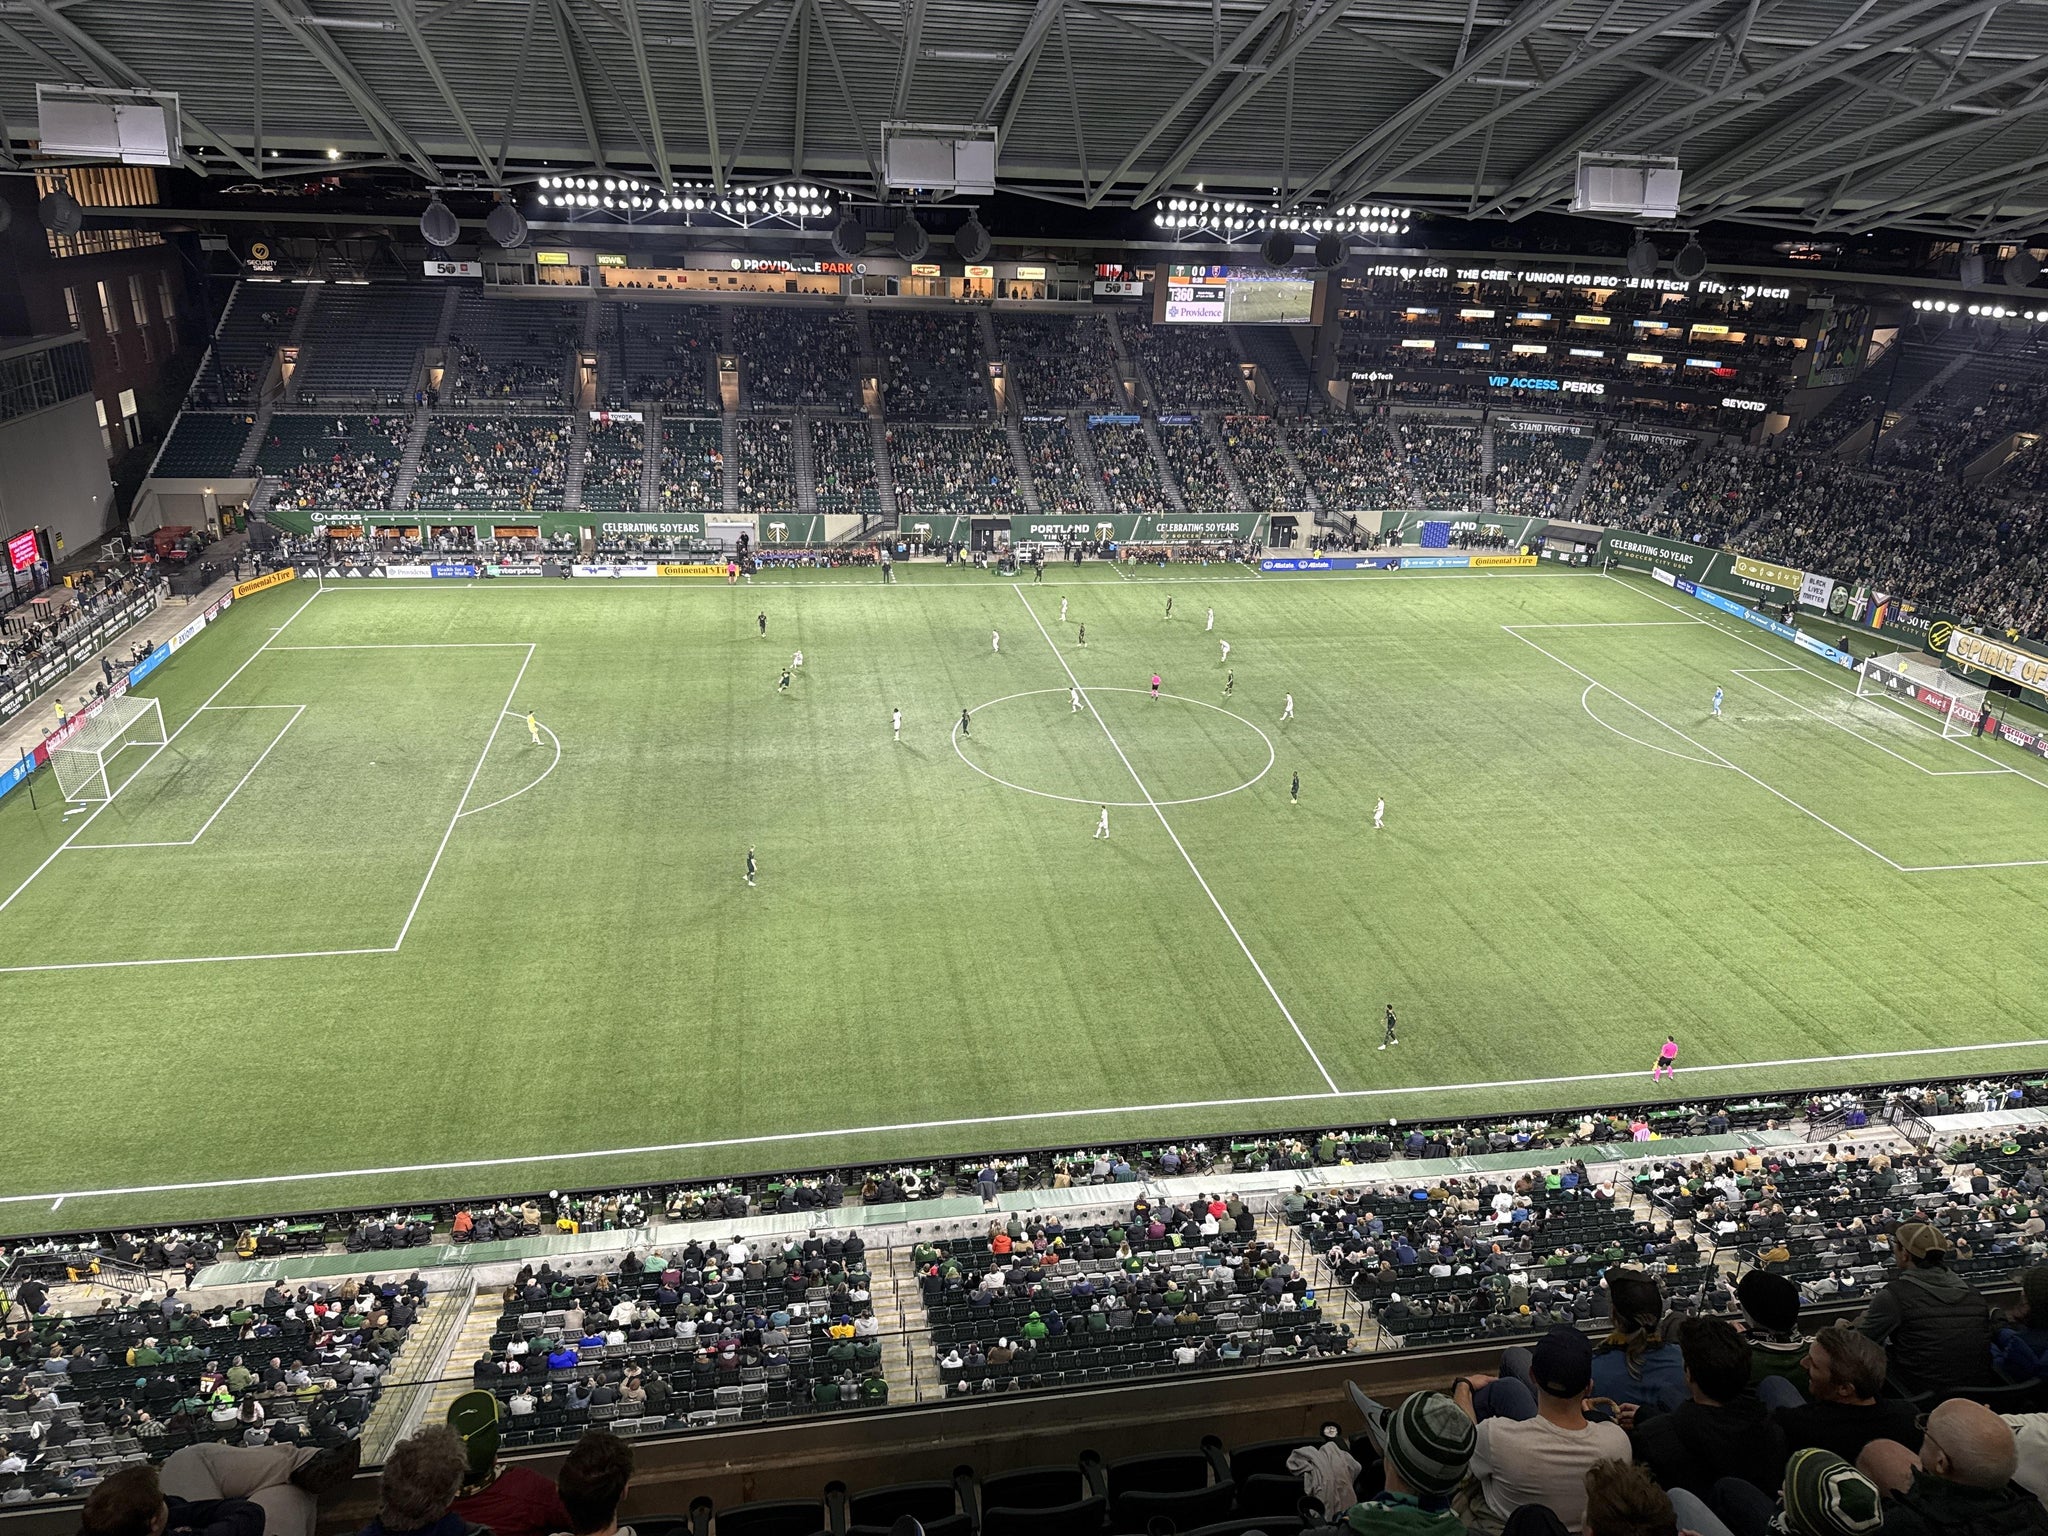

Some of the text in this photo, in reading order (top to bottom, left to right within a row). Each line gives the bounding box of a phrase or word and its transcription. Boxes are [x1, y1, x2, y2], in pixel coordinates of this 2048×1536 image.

[1191, 266, 1206, 276] 0 0
[1457, 269, 1480, 279] THE
[1525, 272, 1564, 284] UNION
[1566, 274, 1590, 286] FOR
[1593, 276, 1638, 288] PEOLE
[1640, 279, 1655, 289] IN
[1656, 279, 1689, 291] TECH
[1169, 288, 1194, 301] T360
[1180, 308, 1222, 317] Providence
[1351, 372, 1393, 380] First Tech
[1488, 376, 1509, 387] VIP
[1562, 381, 1605, 395] PERKS
[1518, 423, 1542, 432] STAND
[1629, 433, 1649, 442] TAND
[602, 522, 699, 533] CELEBRATING 50 YEARS
[1030, 524, 1089, 533] PORTLAND
[1156, 523, 1239, 533] CELEBRATING 50 YEARS
[1610, 539, 1694, 565] CELEBRATING 50 YEARS
[1475, 556, 1512, 566] Continental
[1518, 556, 1533, 565] Tire
[1625, 552, 1653, 562] SOCCER
[1655, 558, 1671, 566] CITY
[397, 566, 430, 575] Providence
[664, 565, 728, 575] Continental Tir
[238, 571, 290, 596] Continental Tire
[1741, 578, 1776, 593] TIMBERS
[1809, 577, 1826, 589] BLACK
[1808, 587, 1824, 596] LIVES
[1802, 592, 1825, 604] MATTER
[1902, 625, 1919, 635] CITY
[74, 643, 92, 660] PORTLAND
[1956, 636, 2048, 685] SPIRIT OF
[1, 694, 24, 714] PORTLAND
[2001, 723, 2036, 745] DISCOUNT
[2006, 734, 2022, 746] TIRE
